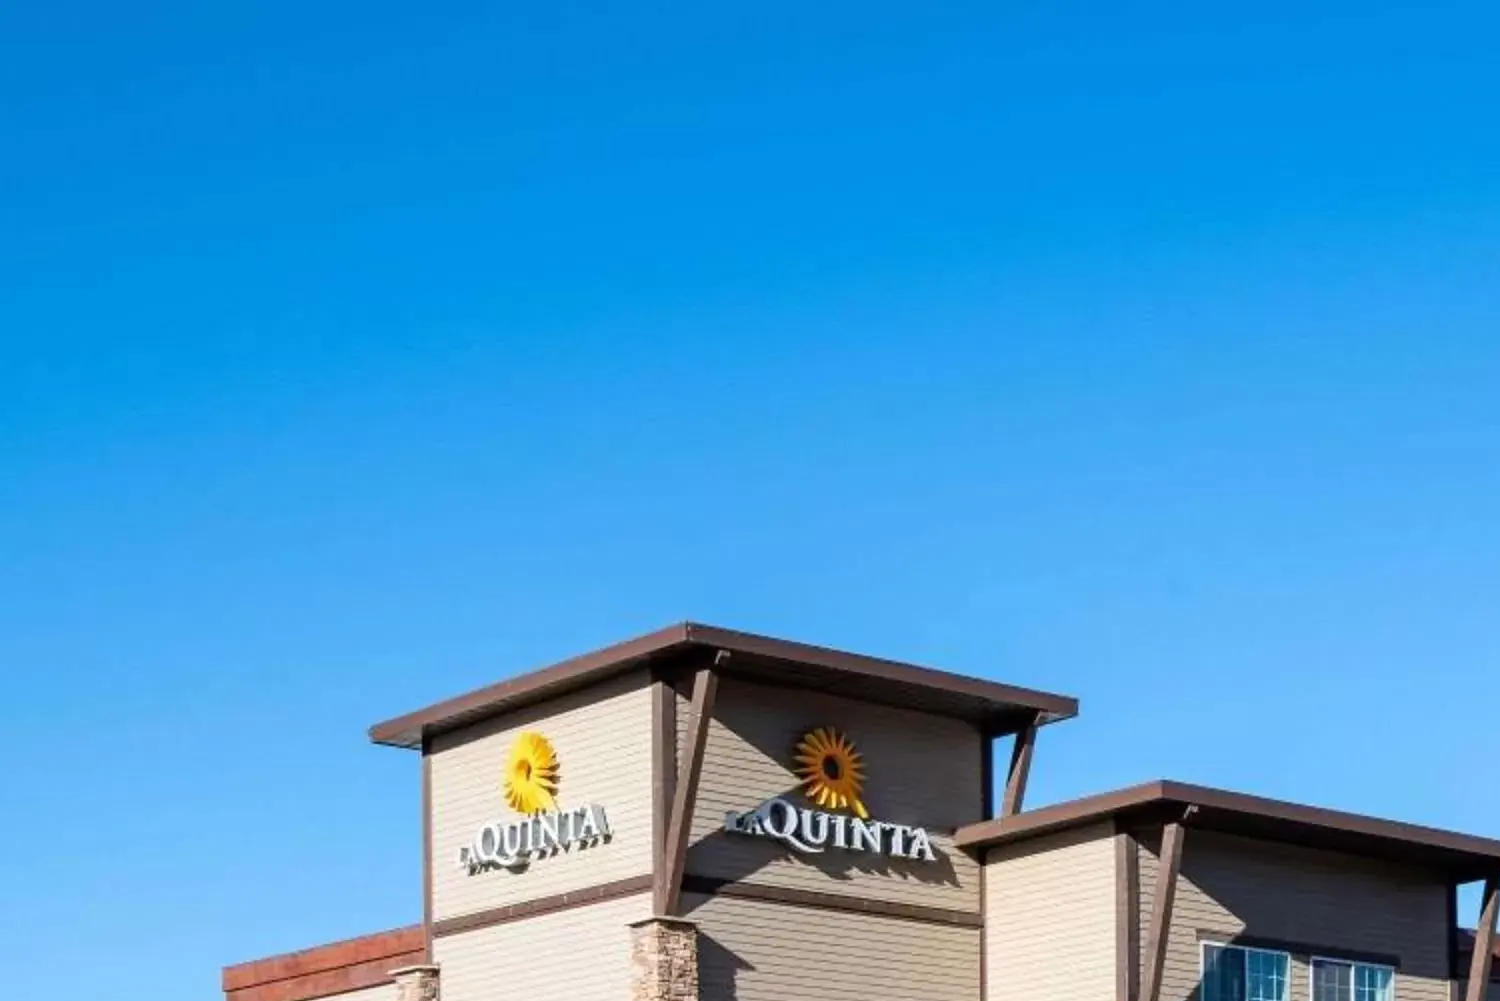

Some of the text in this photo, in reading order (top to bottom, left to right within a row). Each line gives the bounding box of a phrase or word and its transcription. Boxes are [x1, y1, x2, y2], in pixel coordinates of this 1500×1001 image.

[475, 801, 607, 866] QUINTA
[725, 799, 937, 861] LA QUINTA
